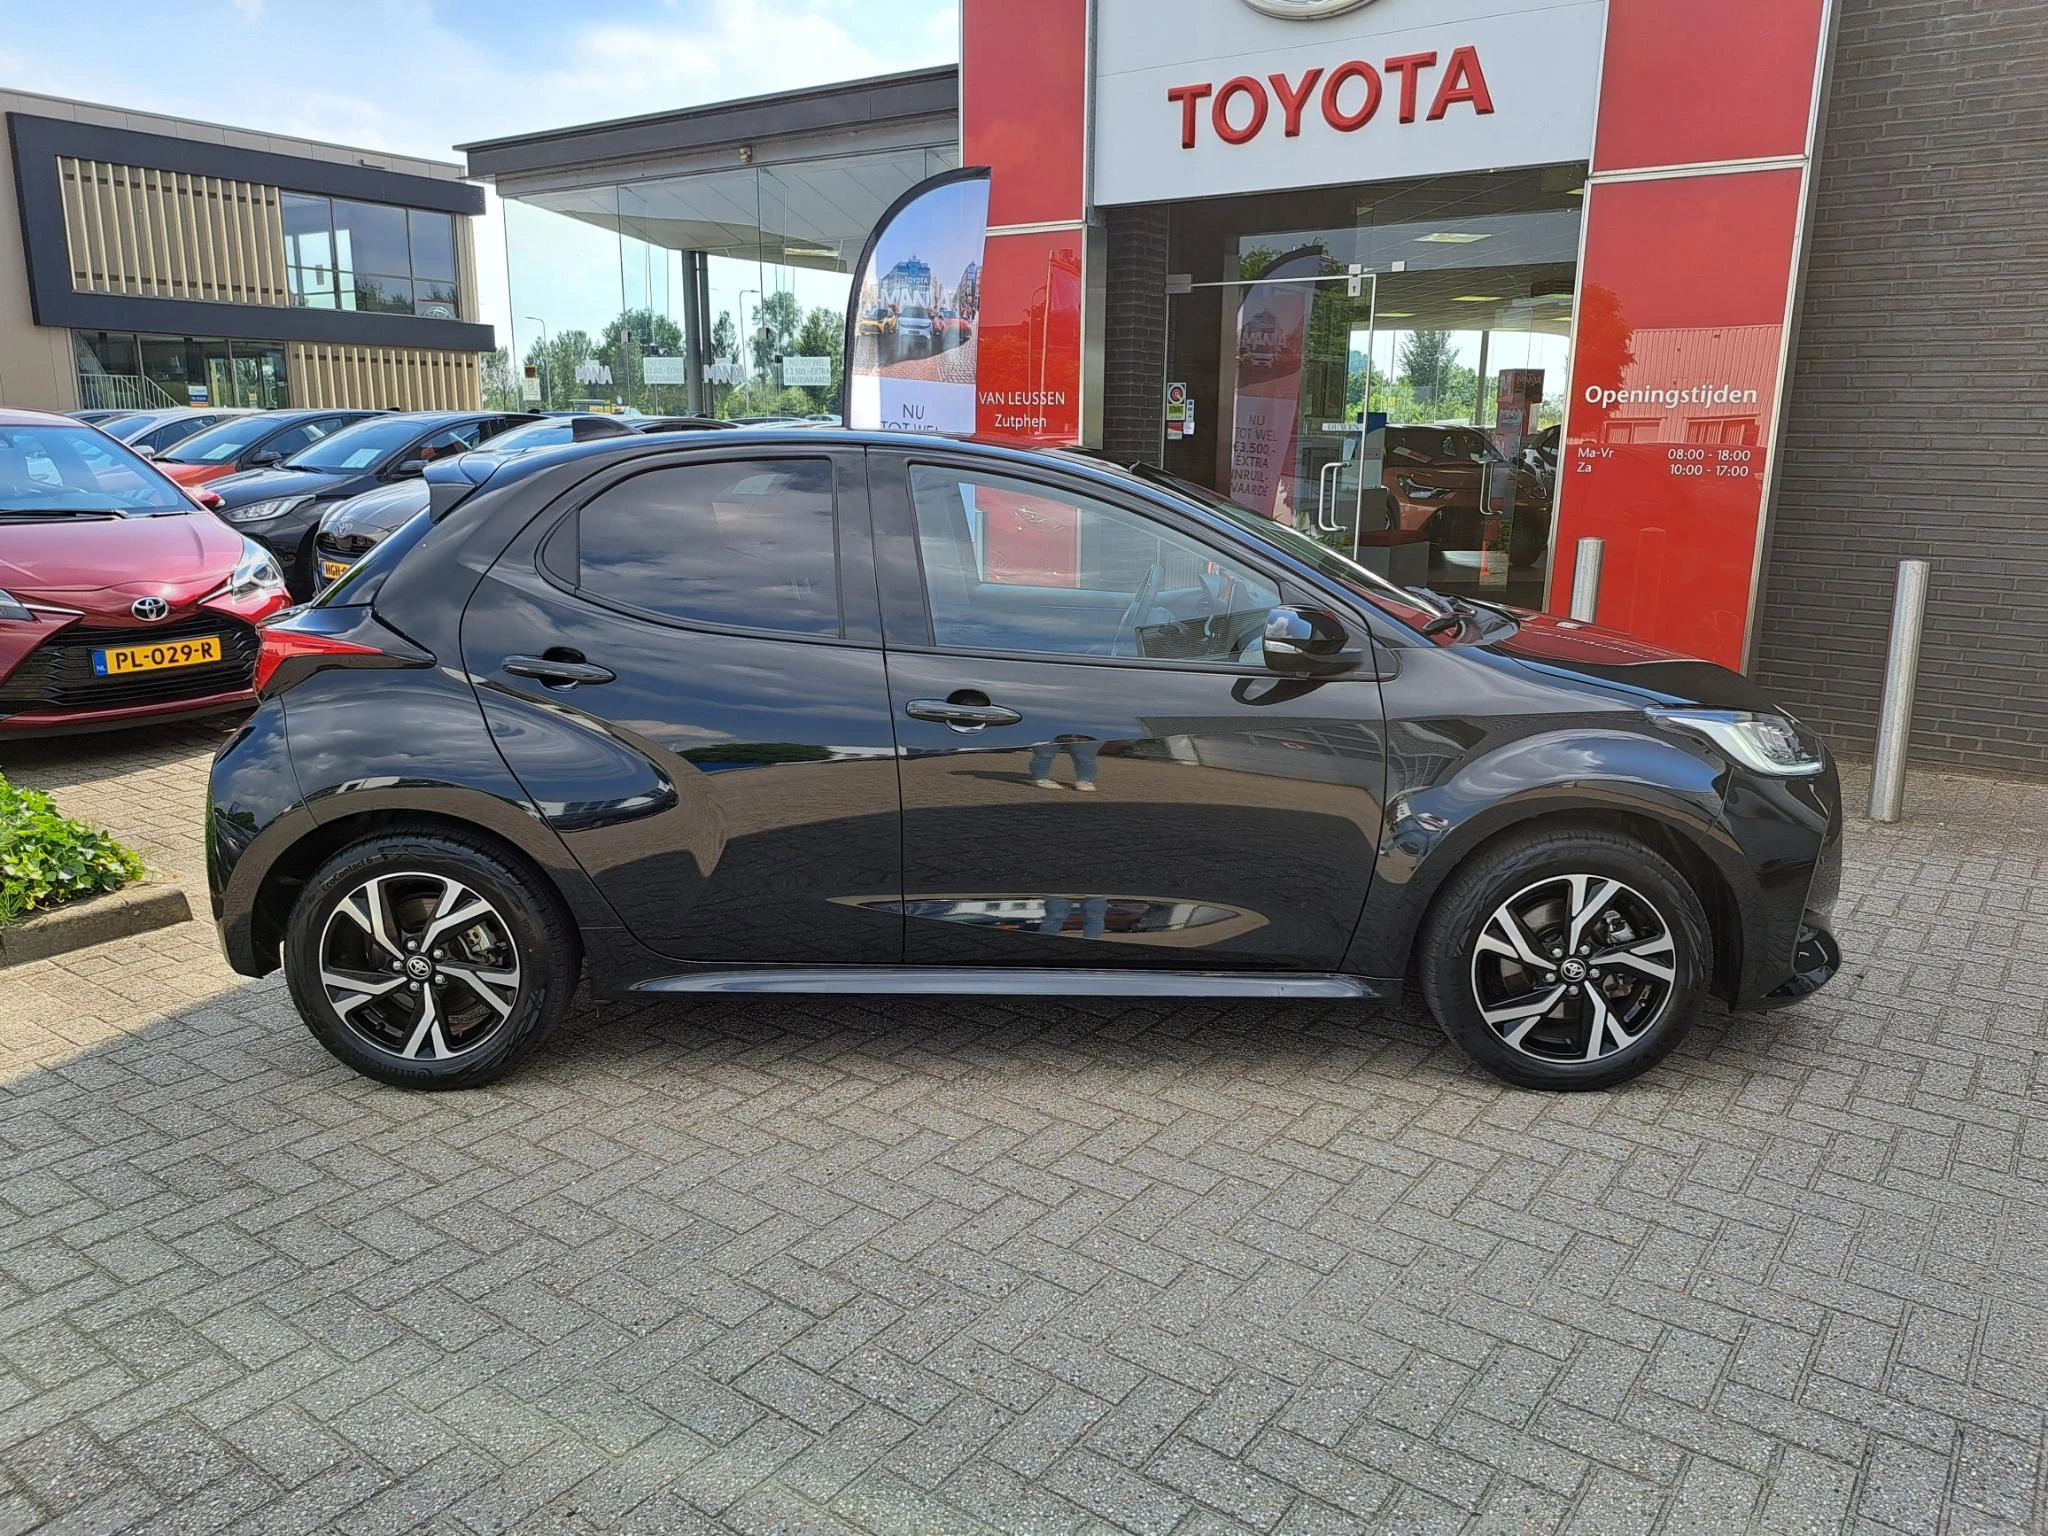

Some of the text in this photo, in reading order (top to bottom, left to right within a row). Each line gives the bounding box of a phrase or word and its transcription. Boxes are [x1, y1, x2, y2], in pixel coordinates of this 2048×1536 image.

[1167, 45, 1495, 149] TOYOTA
[905, 276, 928, 284] TOYOTA
[979, 391, 1065, 406] VAN LEUSSEN
[1584, 384, 1757, 409] Openingstijden
[902, 403, 925, 420] NU
[994, 413, 1047, 429] Zutphen
[1248, 414, 1266, 426] NU
[1235, 427, 1252, 440] TOT
[1236, 455, 1269, 469] EXTRA
[1578, 447, 1615, 458] Ma-Vr
[1668, 448, 1705, 461] 08:00
[1718, 449, 1751, 462] 18:00
[1577, 462, 1592, 473] Za
[1670, 464, 1703, 476] 10:00
[1716, 465, 1749, 477] 17:00
[115, 641, 213, 670] PL-029-R
[321, 855, 373, 892] EcoContact 6
